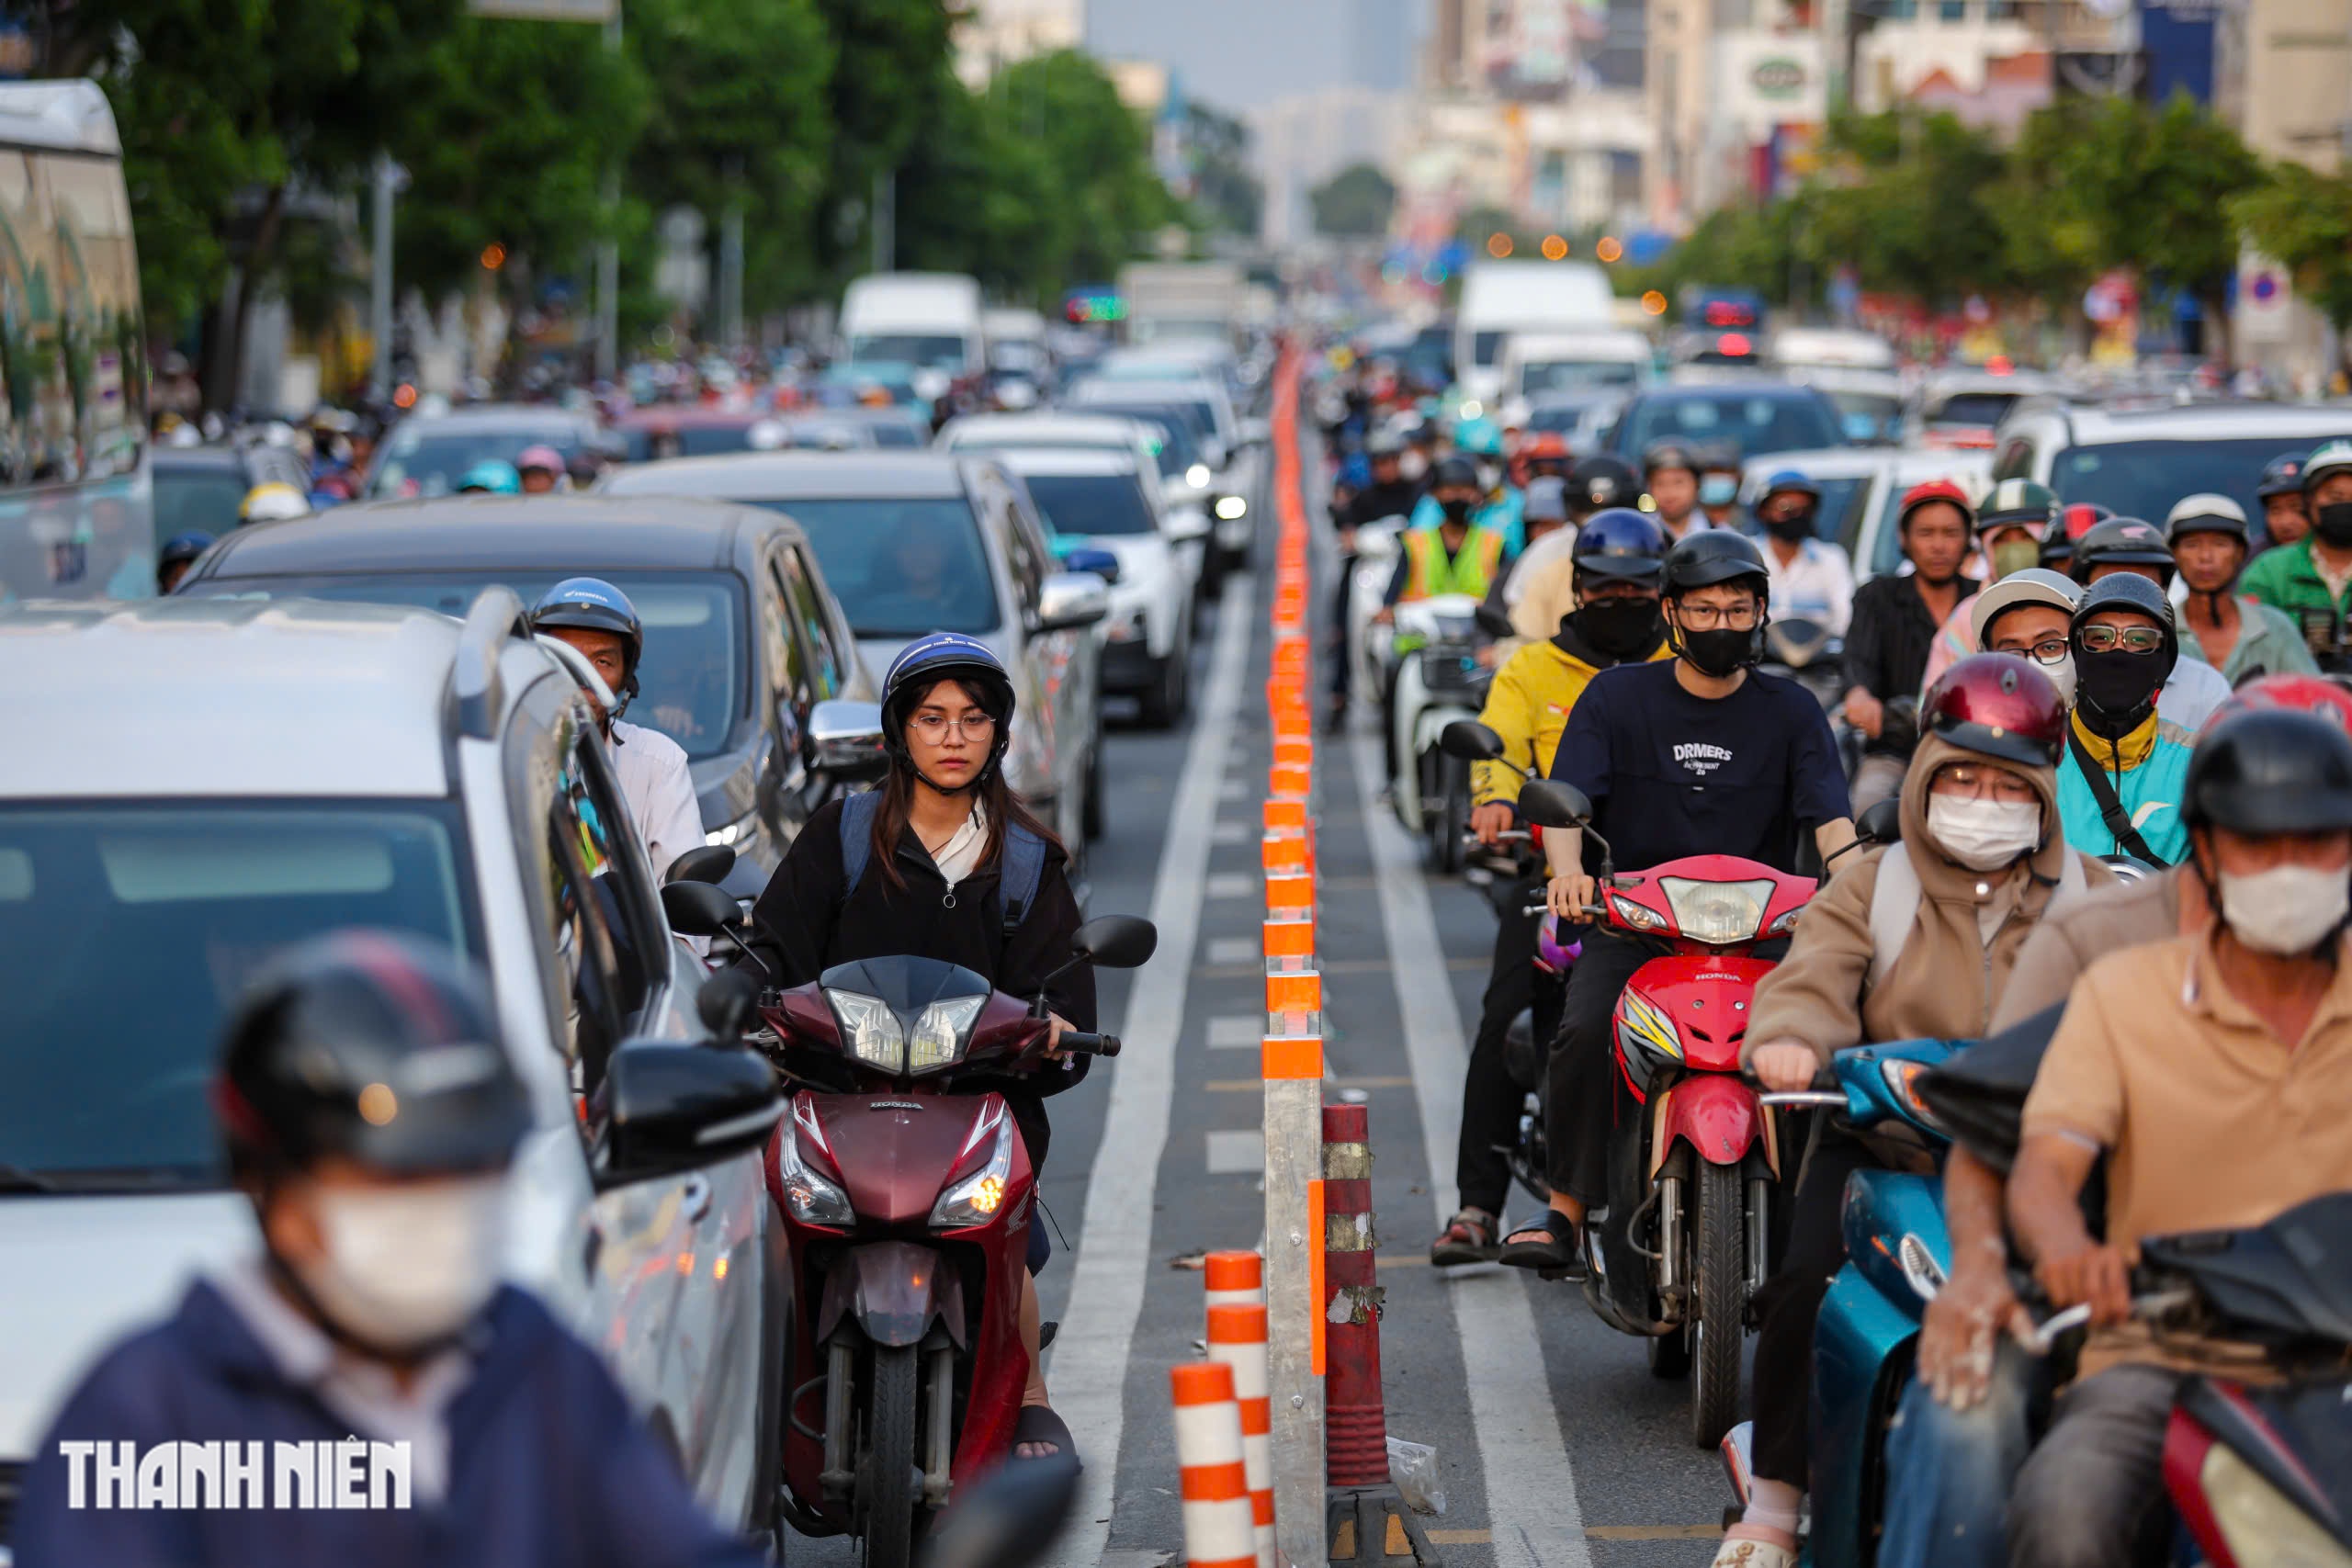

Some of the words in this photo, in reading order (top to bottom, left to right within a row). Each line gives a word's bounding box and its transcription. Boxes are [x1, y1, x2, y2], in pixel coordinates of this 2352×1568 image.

[1673, 742, 1733, 761] DRMERS
[1695, 972, 1743, 982] HONDA
[869, 1101, 924, 1111] HONDA
